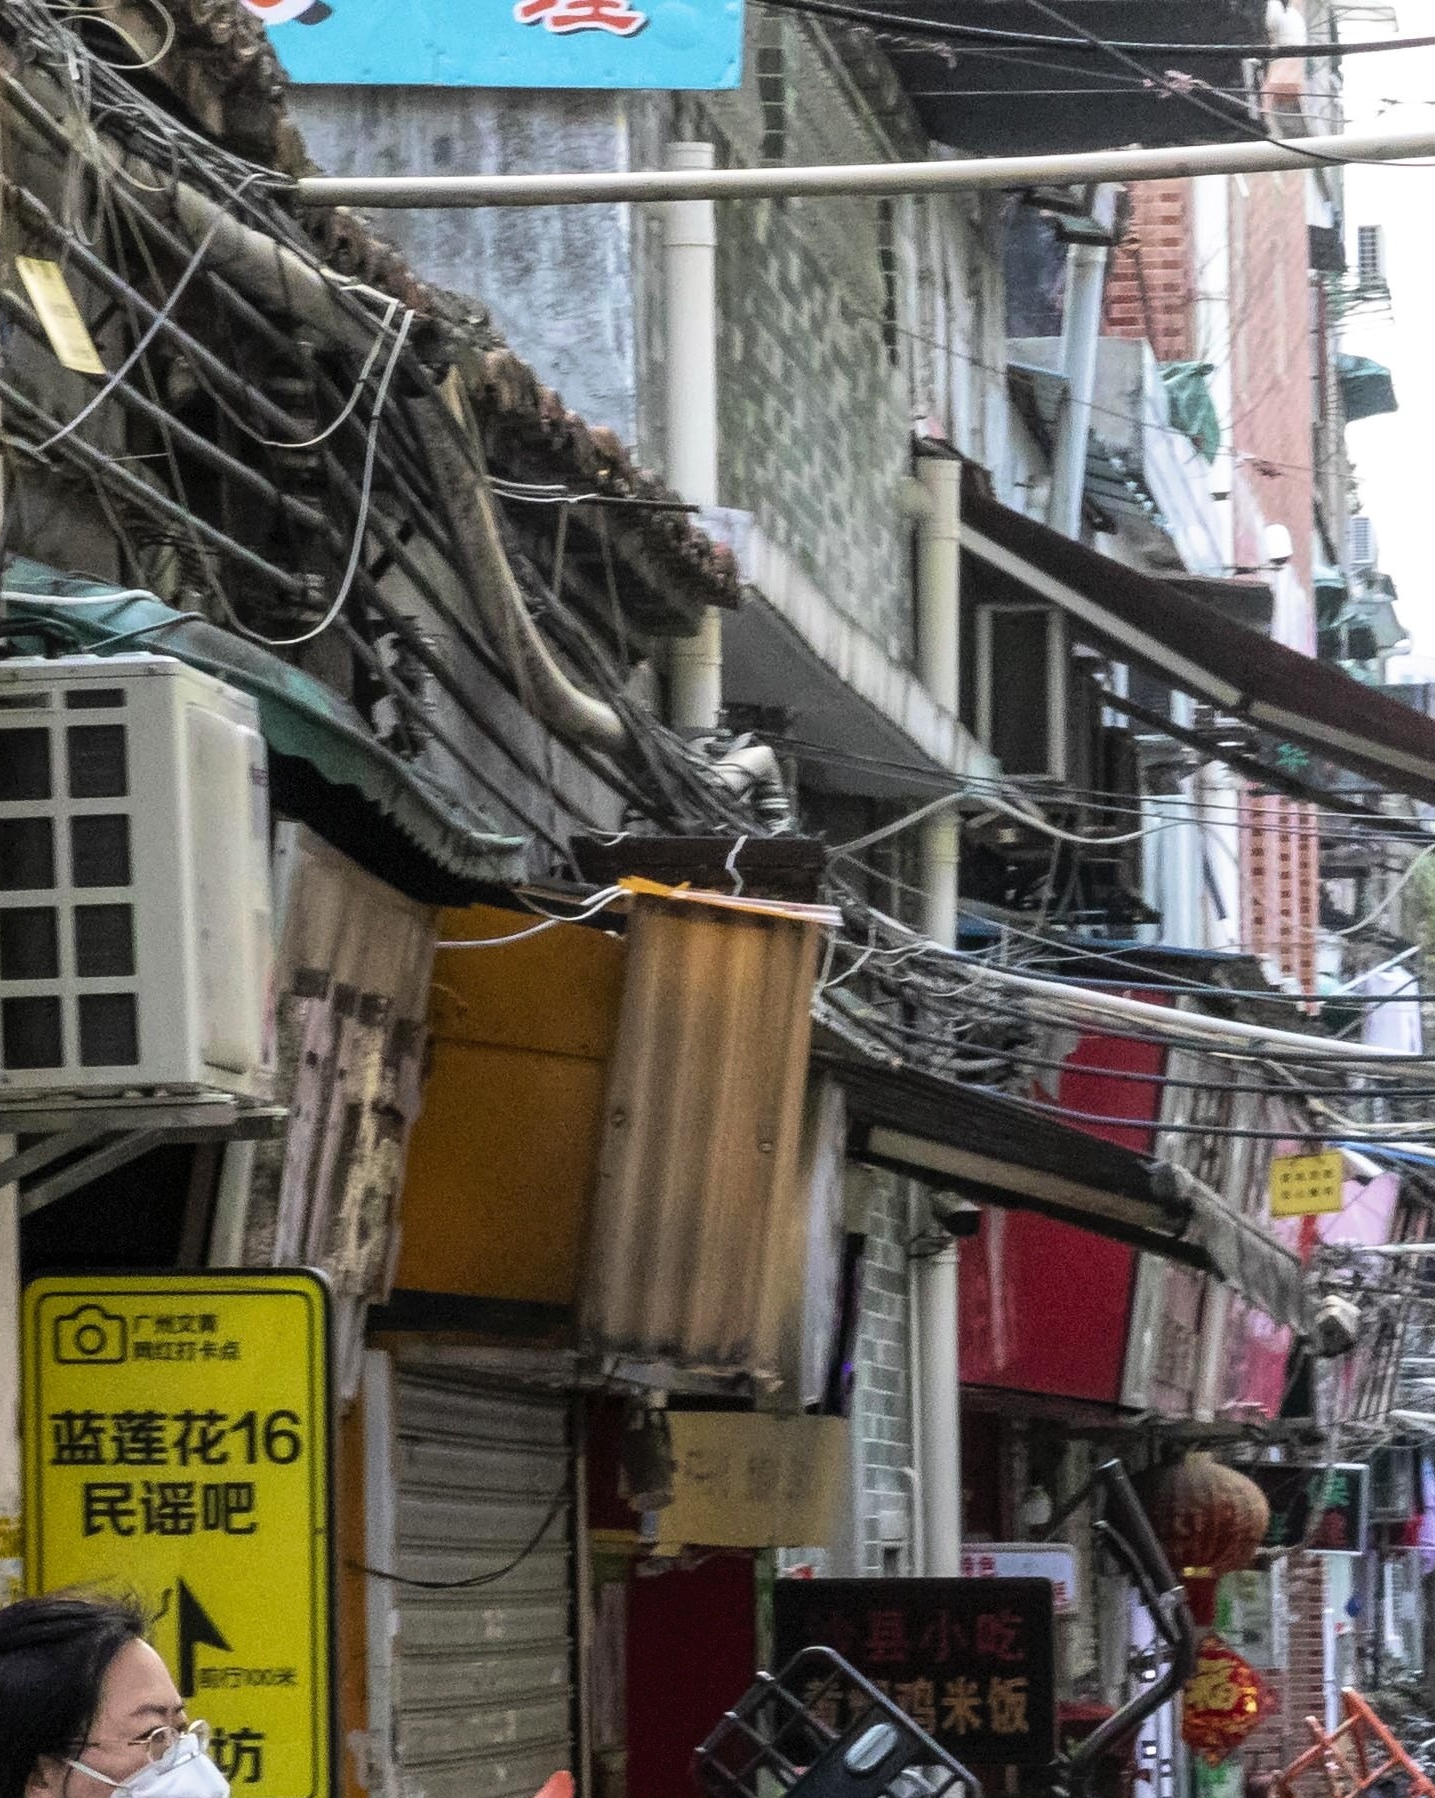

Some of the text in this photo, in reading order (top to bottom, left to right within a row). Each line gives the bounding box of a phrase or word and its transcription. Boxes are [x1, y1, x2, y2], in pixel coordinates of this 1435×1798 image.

[48, 1408, 302, 1467] 蓝莲花16
[81, 1480, 258, 1538] 民谣吧
